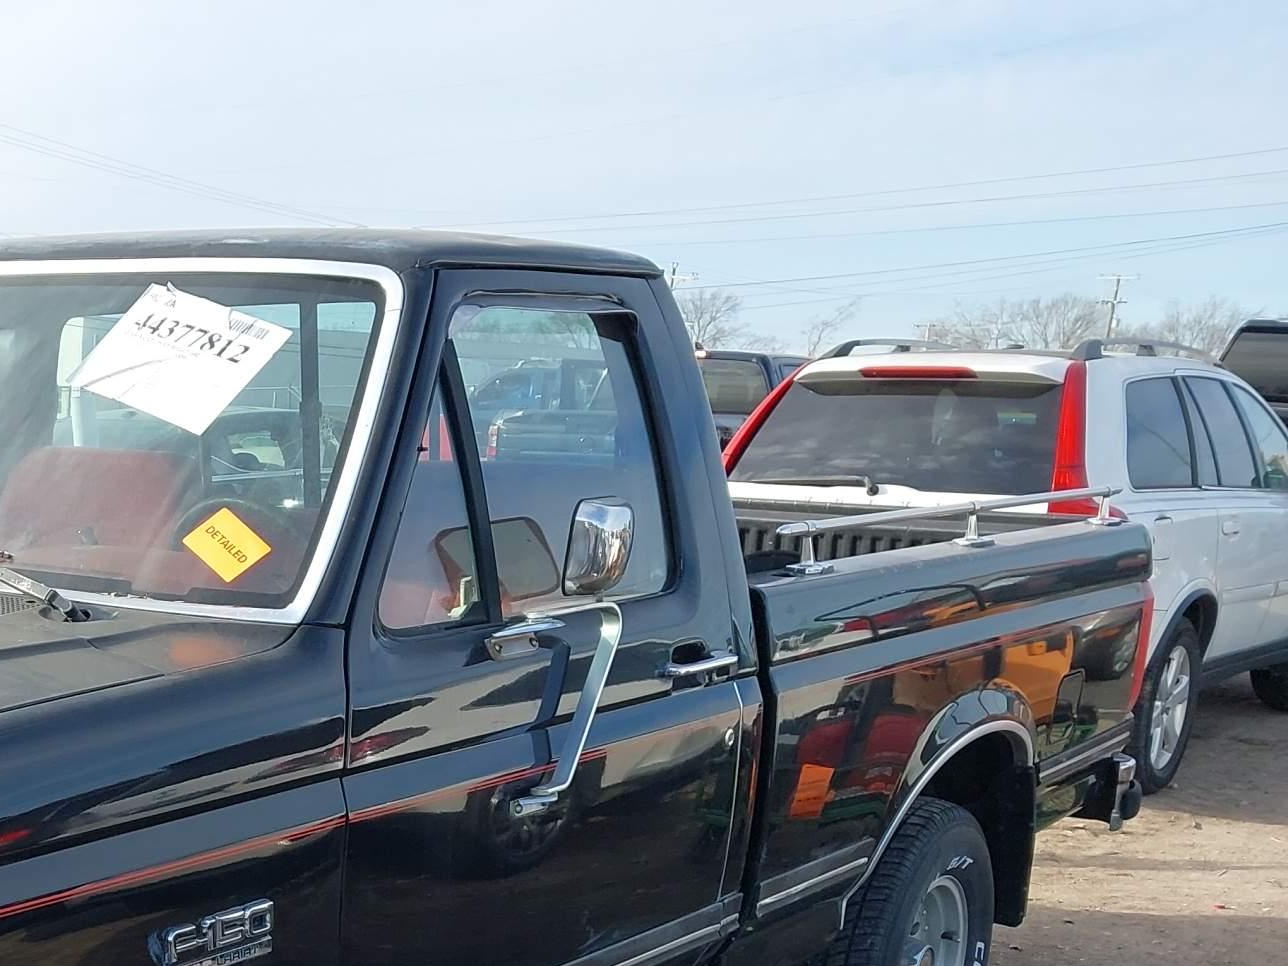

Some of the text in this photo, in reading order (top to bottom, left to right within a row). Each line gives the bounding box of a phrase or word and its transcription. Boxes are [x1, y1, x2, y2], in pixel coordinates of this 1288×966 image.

[134, 313, 251, 364] 44377812
[205, 525, 248, 564] DETAILED
[165, 898, 274, 963] F-150
